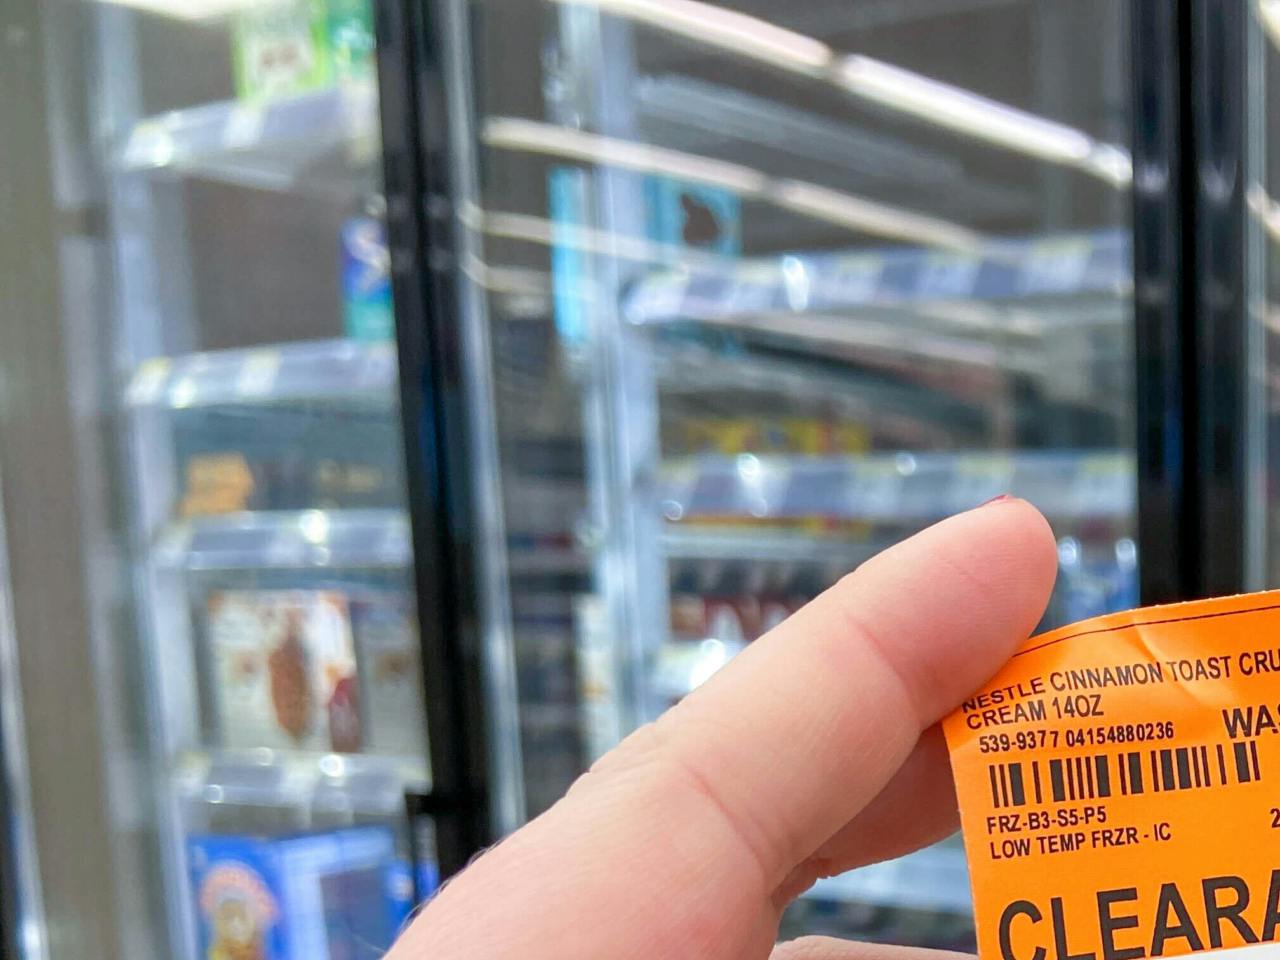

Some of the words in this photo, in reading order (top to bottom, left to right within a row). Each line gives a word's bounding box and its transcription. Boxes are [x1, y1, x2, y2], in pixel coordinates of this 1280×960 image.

[961, 677, 1046, 713] NESTLE
[1049, 661, 1163, 692] CINNAMON
[1166, 655, 1231, 682] TOAST
[966, 699, 1047, 730] CREAM
[1052, 694, 1104, 719] 14OZ
[979, 729, 1059, 754] 539-9377
[1066, 721, 1174, 747] 04154880236
[986, 805, 1106, 835] FRZ-B3-S5-P5
[990, 838, 1030, 860] LOW
[1036, 832, 1085, 854] TEMP
[1092, 827, 1138, 849] FRZR
[1154, 822, 1171, 841] IC
